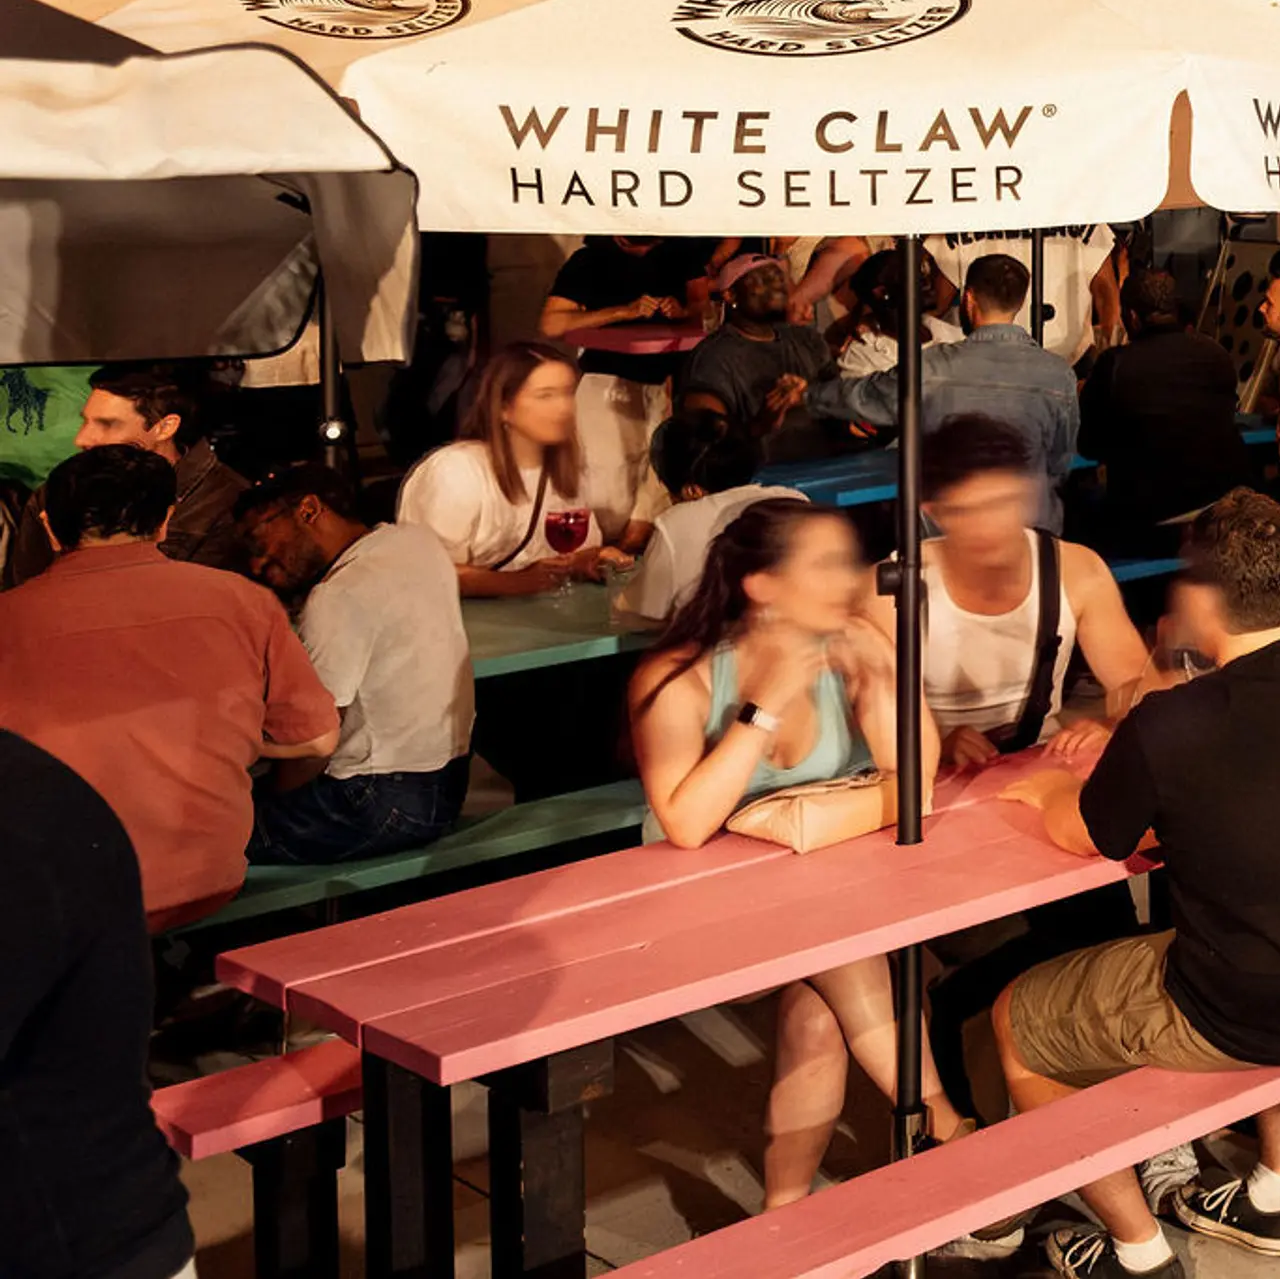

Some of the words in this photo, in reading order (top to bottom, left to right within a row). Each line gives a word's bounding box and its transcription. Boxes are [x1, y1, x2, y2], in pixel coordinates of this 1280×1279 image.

[287, 17, 374, 36] HARD
[705, 30, 806, 53] HARD
[824, 4, 957, 52] SELTZER
[498, 105, 771, 154] WHITE
[509, 166, 693, 208] HARD
[736, 165, 1023, 208] SELTZER
